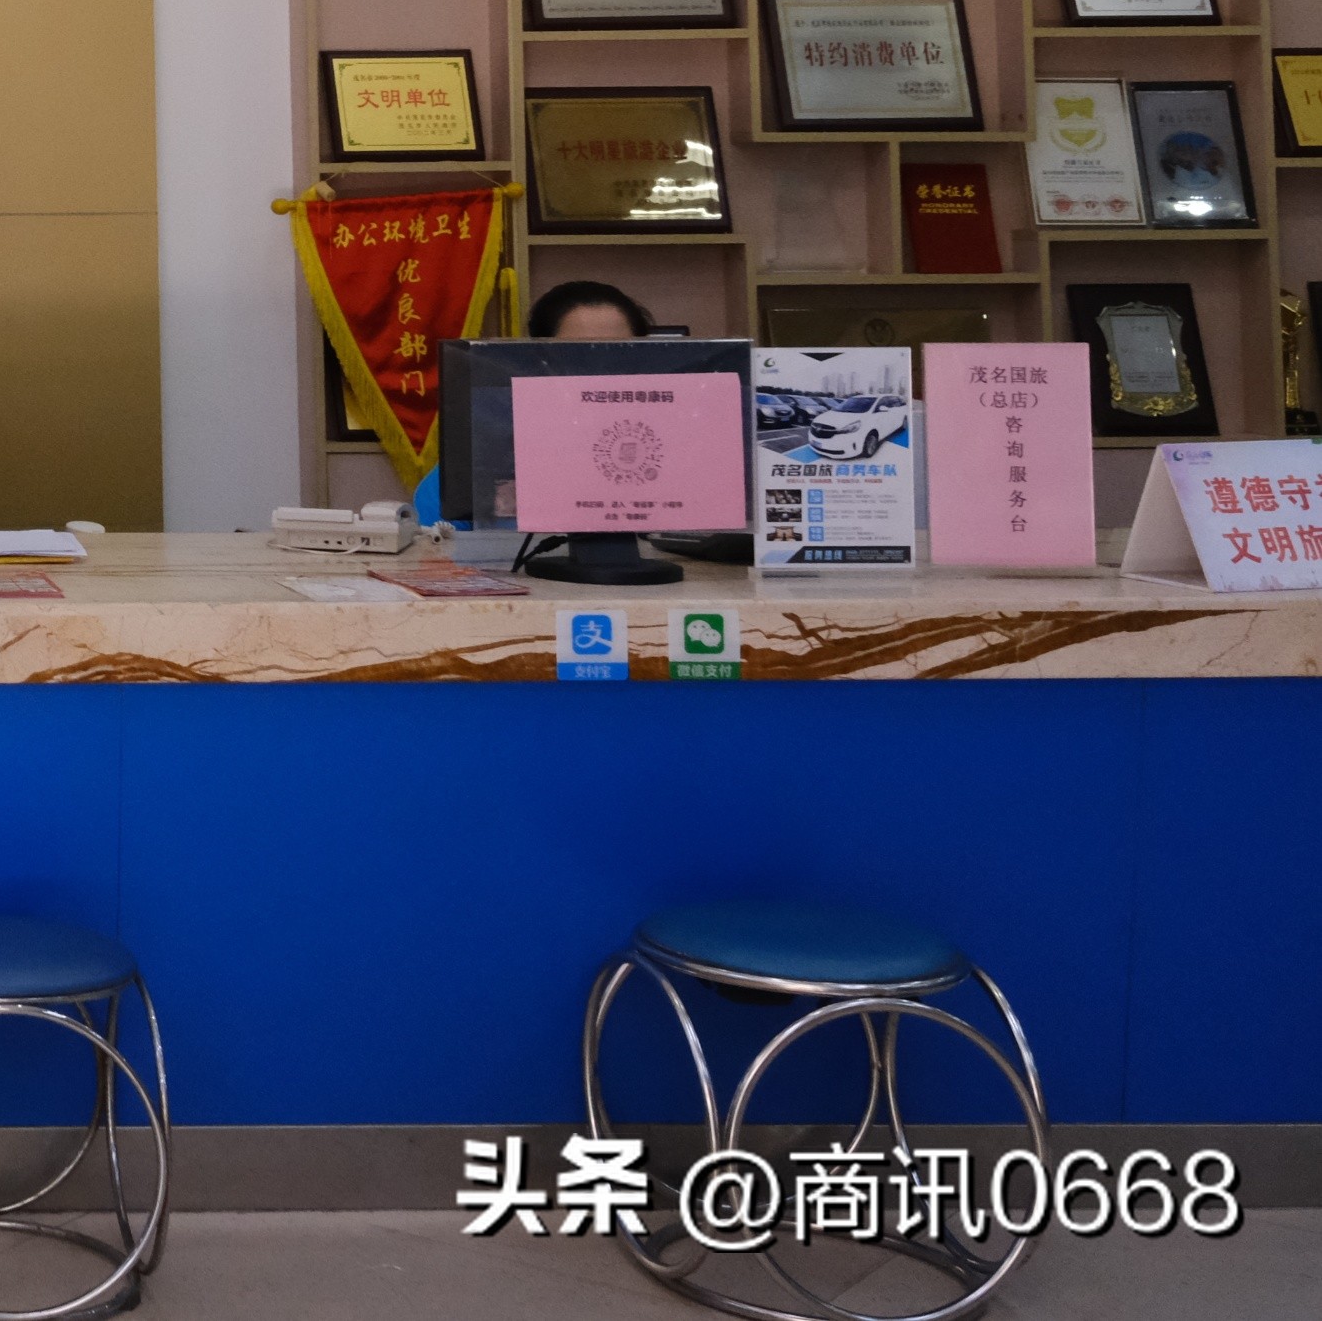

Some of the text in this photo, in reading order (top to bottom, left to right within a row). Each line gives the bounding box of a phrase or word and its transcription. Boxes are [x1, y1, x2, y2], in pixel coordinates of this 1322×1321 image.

[803, 41, 945, 67] 特约消费单位
[356, 88, 452, 108] 文明单位
[916, 183, 976, 198] 荣誉证书
[332, 210, 472, 249] 办公环境卫生
[393, 258, 428, 398] 优良部门
[969, 366, 1048, 384] 茂名国旅
[581, 391, 674, 404] 欢迎使用粤康码
[771, 463, 898, 477] 茂名国旅 商务车队
[1005, 415, 1028, 533] 咨询服务台
[1203, 473, 1322, 514] 遵德守
[574, 664, 612, 678] 支付宝
[676, 663, 733, 678] 微信支付
